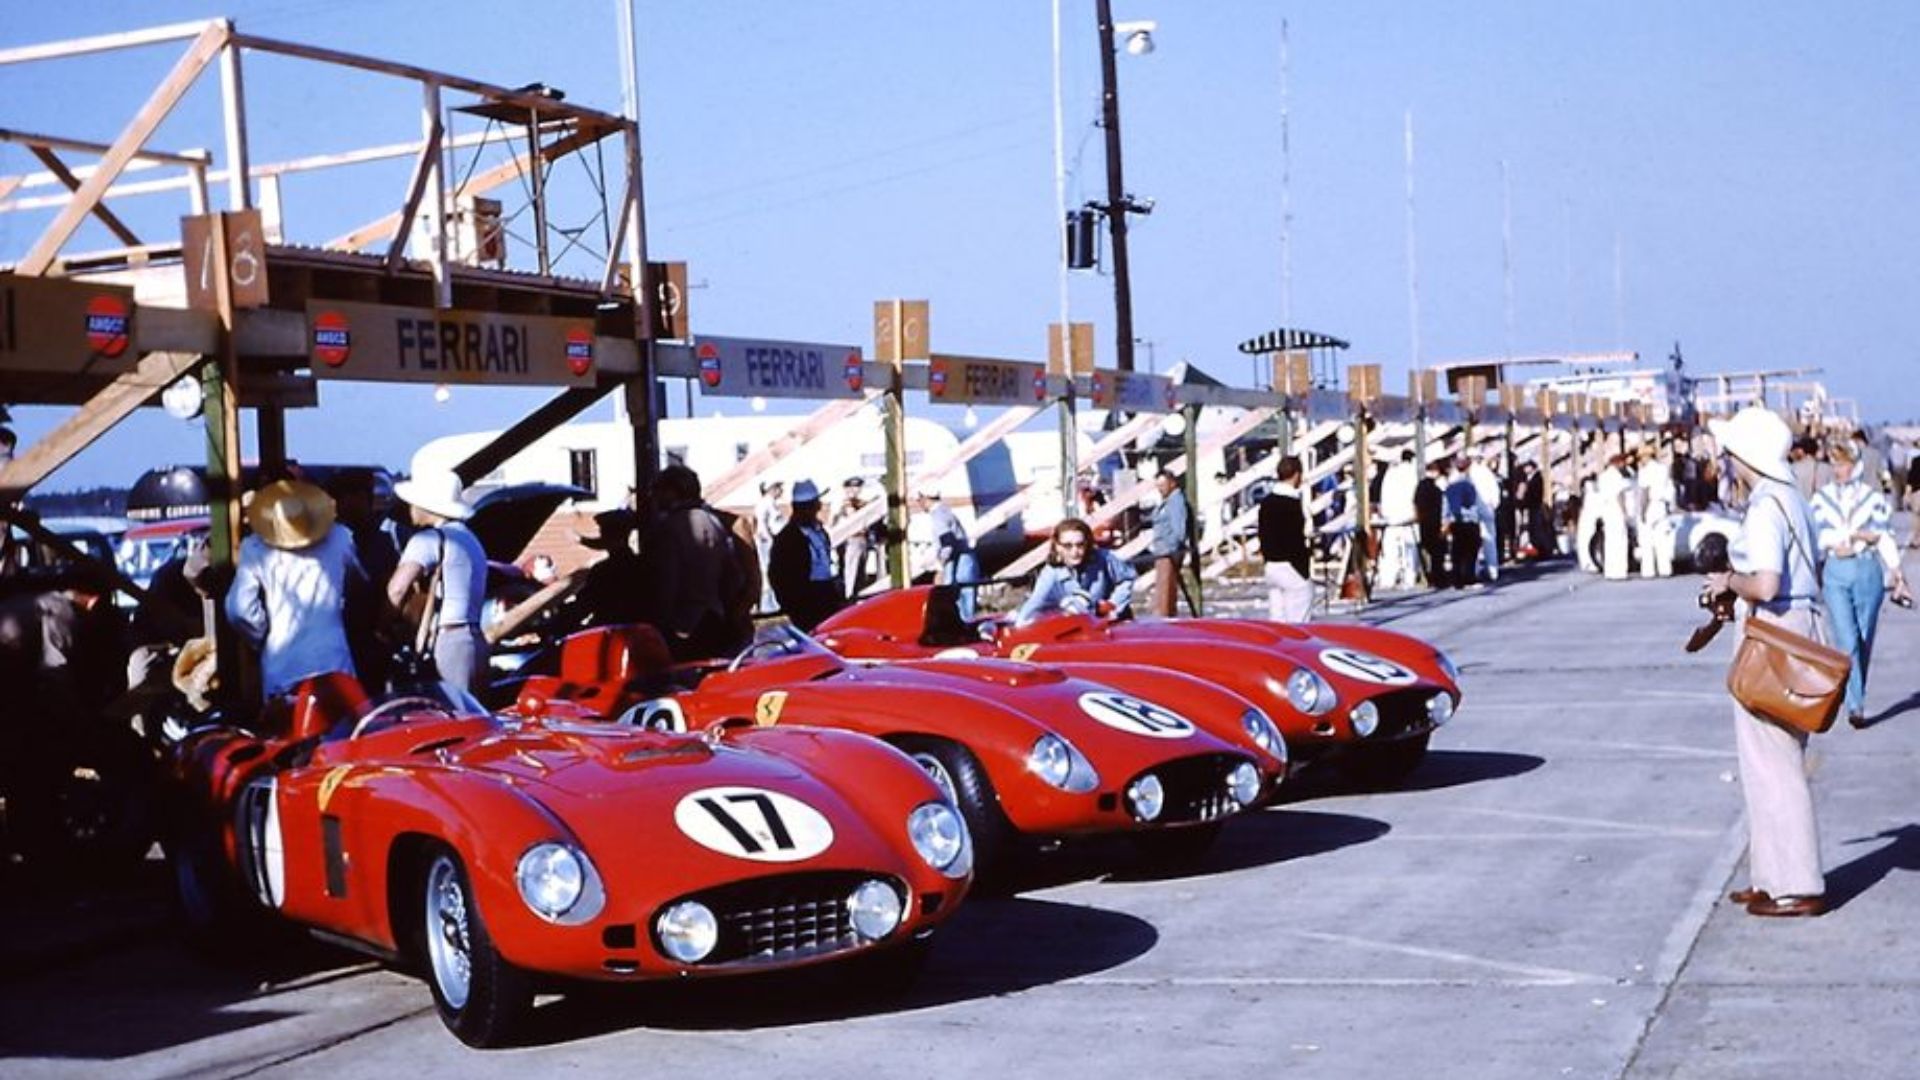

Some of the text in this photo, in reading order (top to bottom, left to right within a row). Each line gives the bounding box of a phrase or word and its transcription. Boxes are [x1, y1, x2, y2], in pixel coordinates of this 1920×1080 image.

[396, 318, 528, 375] FERRARI
[745, 348, 826, 388] FERRARI
[1326, 652, 1409, 680] 19
[1088, 697, 1189, 732] 18
[693, 793, 797, 854] 17
